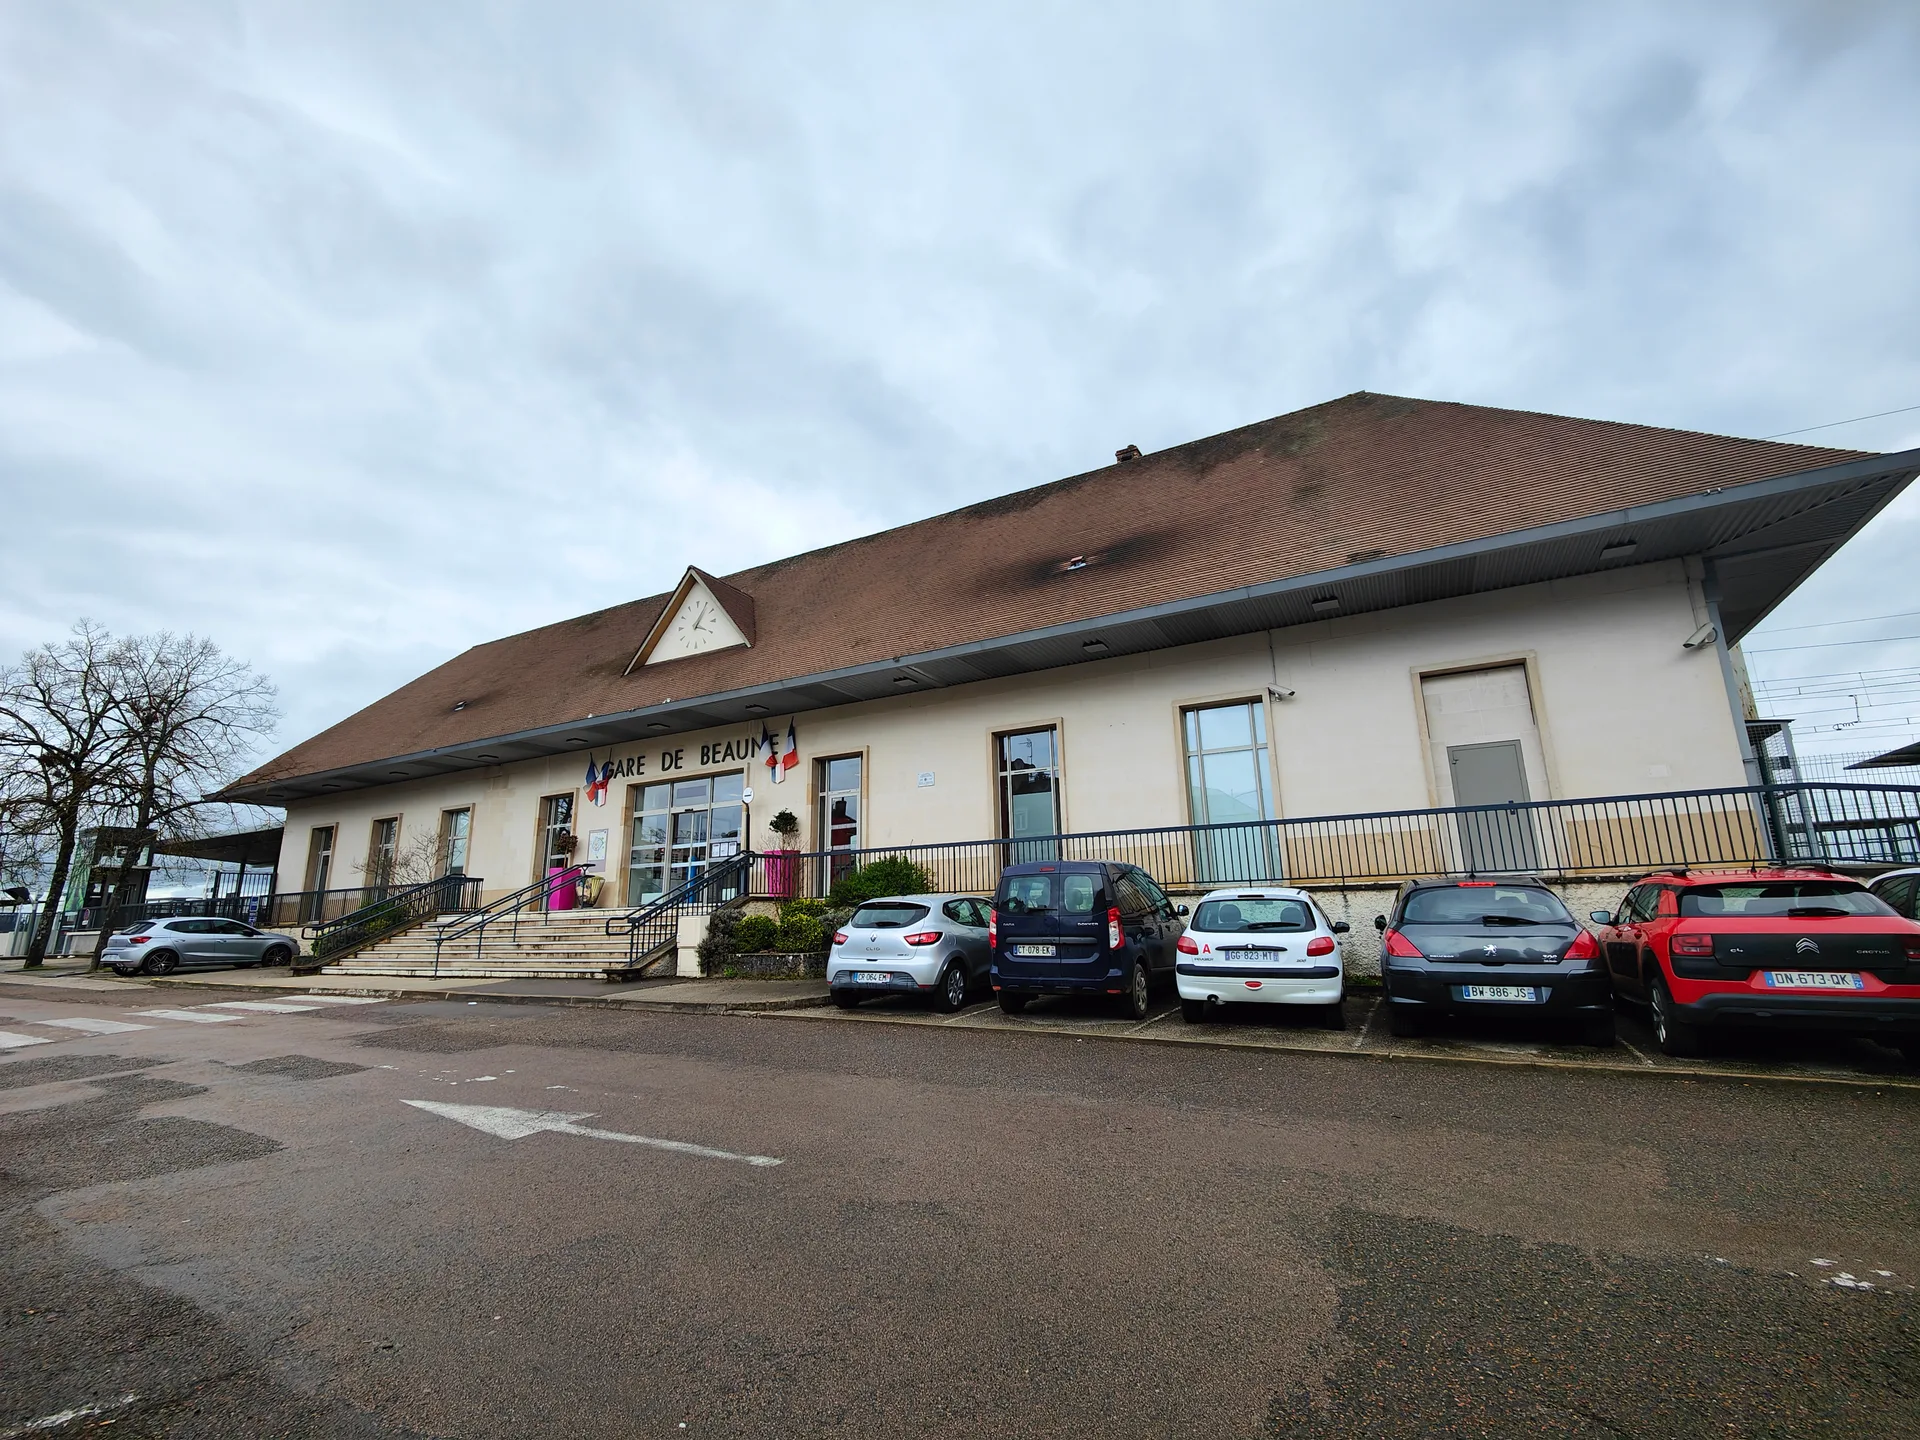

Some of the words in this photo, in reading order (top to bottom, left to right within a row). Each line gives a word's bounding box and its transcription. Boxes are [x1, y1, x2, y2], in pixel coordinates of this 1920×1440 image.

[601, 755, 646, 779] GARE
[661, 748, 684, 772] DE
[700, 733, 779, 766] BEAUNE
[1202, 944, 1211, 954] A
[1775, 973, 1850, 985] DN-673-QK
[1471, 987, 1526, 998] BW-986-JS
